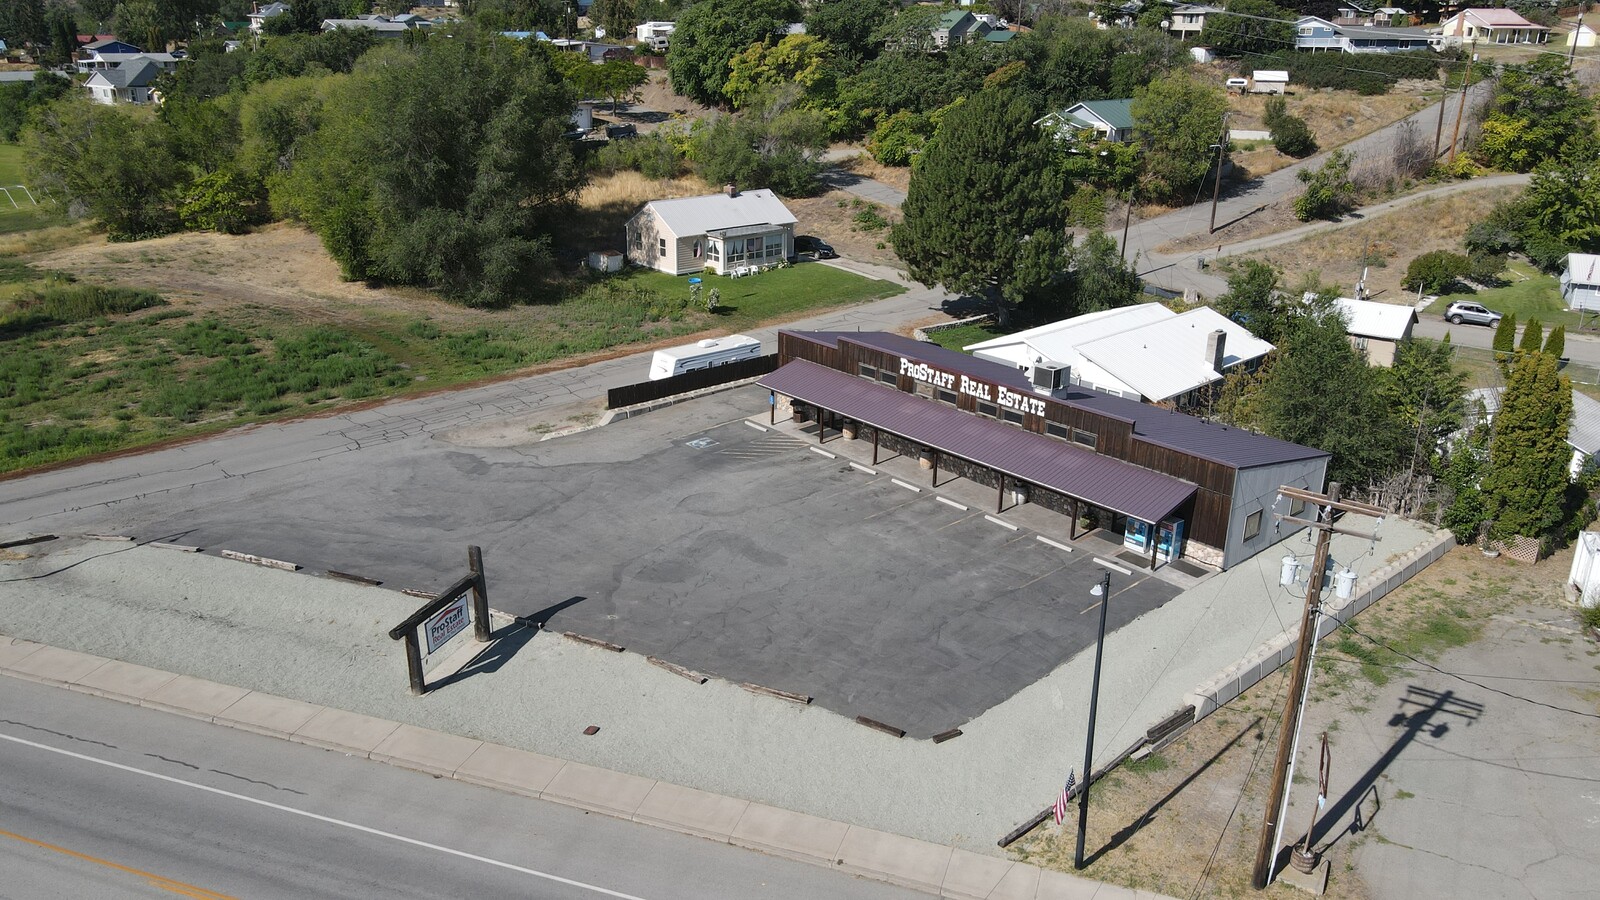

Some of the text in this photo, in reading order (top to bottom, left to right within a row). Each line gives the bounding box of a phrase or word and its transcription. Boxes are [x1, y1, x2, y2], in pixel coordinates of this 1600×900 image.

[959, 374, 991, 400] REAL
[997, 385, 1046, 417] ESTATE
[431, 606, 463, 637] ProStaff
[432, 630, 446, 644] Real
[446, 617, 465, 634] Estate
